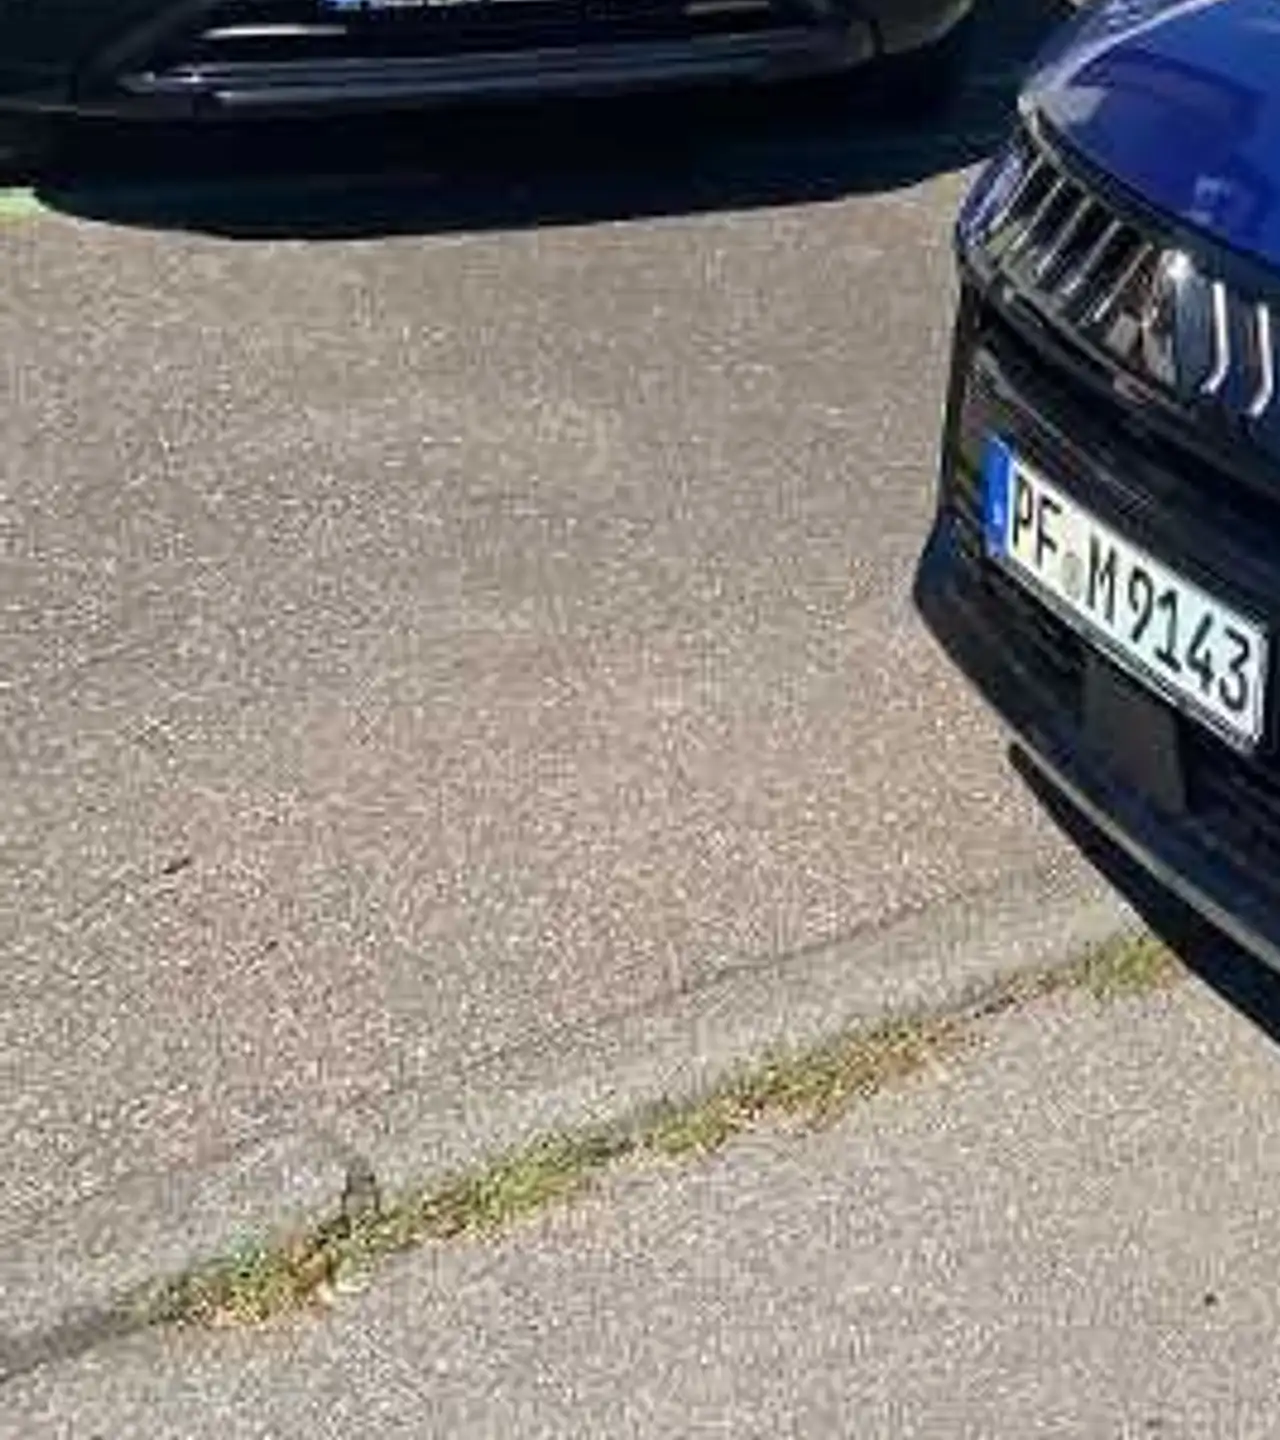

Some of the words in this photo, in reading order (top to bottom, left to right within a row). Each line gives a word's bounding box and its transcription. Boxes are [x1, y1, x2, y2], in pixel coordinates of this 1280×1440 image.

[1011, 473, 1064, 569] PF
[1084, 531, 1118, 627] M
[1128, 565, 1251, 712] 9143
